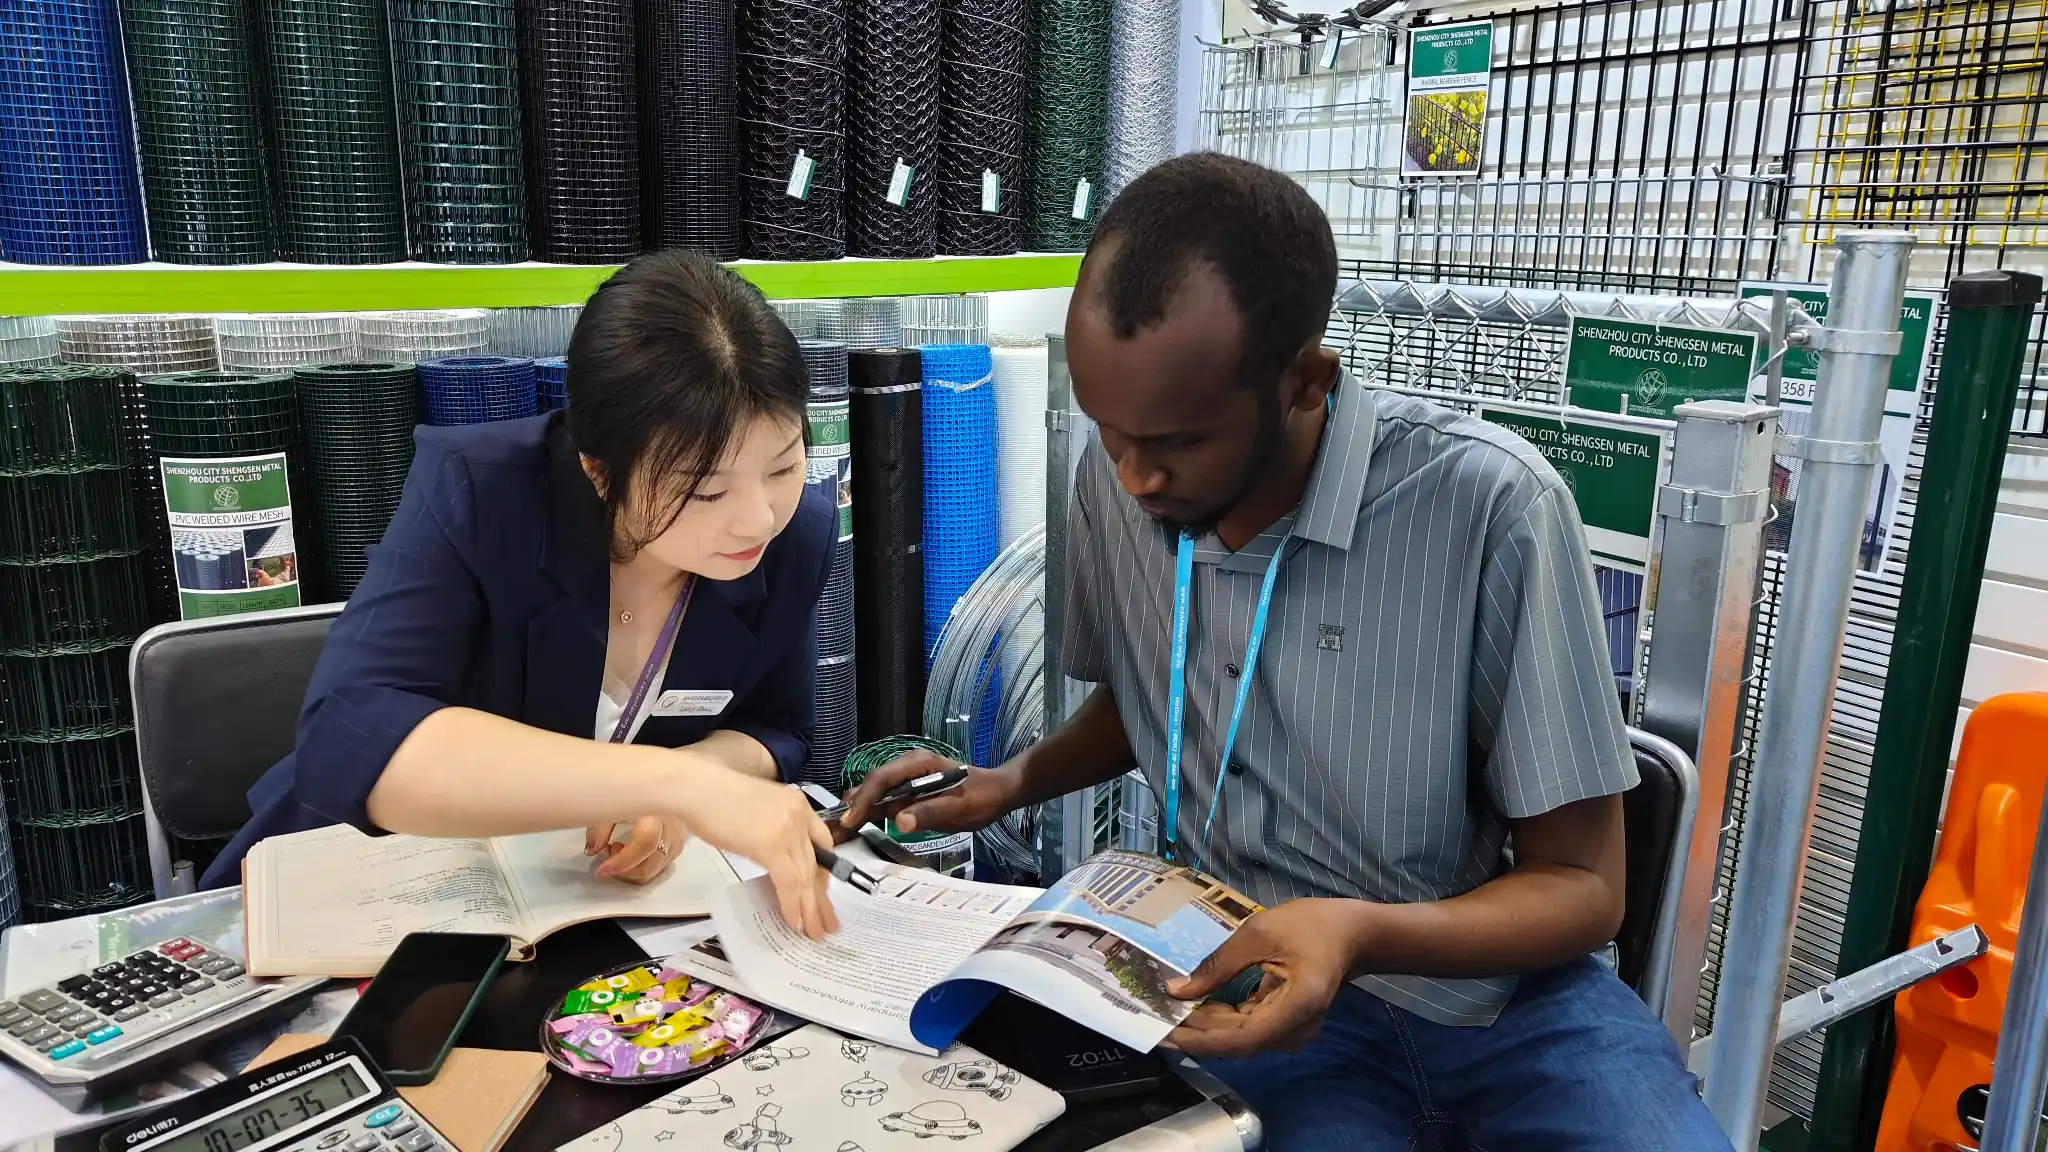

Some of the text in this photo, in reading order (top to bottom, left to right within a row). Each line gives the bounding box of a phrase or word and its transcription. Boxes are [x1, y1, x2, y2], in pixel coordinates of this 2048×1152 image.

[1416, 34, 1440, 42] SHENZHOU
[1451, 31, 1474, 39] SHENGSEN
[1432, 40, 1453, 48] PRODUCTS
[1421, 78, 1438, 86] ANIMAL
[1804, 300, 1825, 312] CITY
[1578, 326, 1746, 357] SHENZHOU CITY SHENGSEN METAL
[1609, 346, 1660, 361] PRODUCTS
[1781, 382, 1805, 396] 358
[1540, 429, 1560, 442] CITY
[1561, 432, 1614, 451] SHENGSEN
[1618, 442, 1650, 458] METAL
[166, 467, 202, 475] SHENZHOU
[221, 465, 261, 475] SHENGSEN
[261, 462, 282, 472] METAL
[189, 476, 230, 484] PRODUCTS
[176, 515, 191, 524] PVC
[232, 513, 258, 523] WIRE
[259, 510, 284, 520] MESH
[918, 841, 944, 850] GARDEN
[944, 835, 960, 845] MESH
[1066, 1048, 1126, 1066] 11:02
